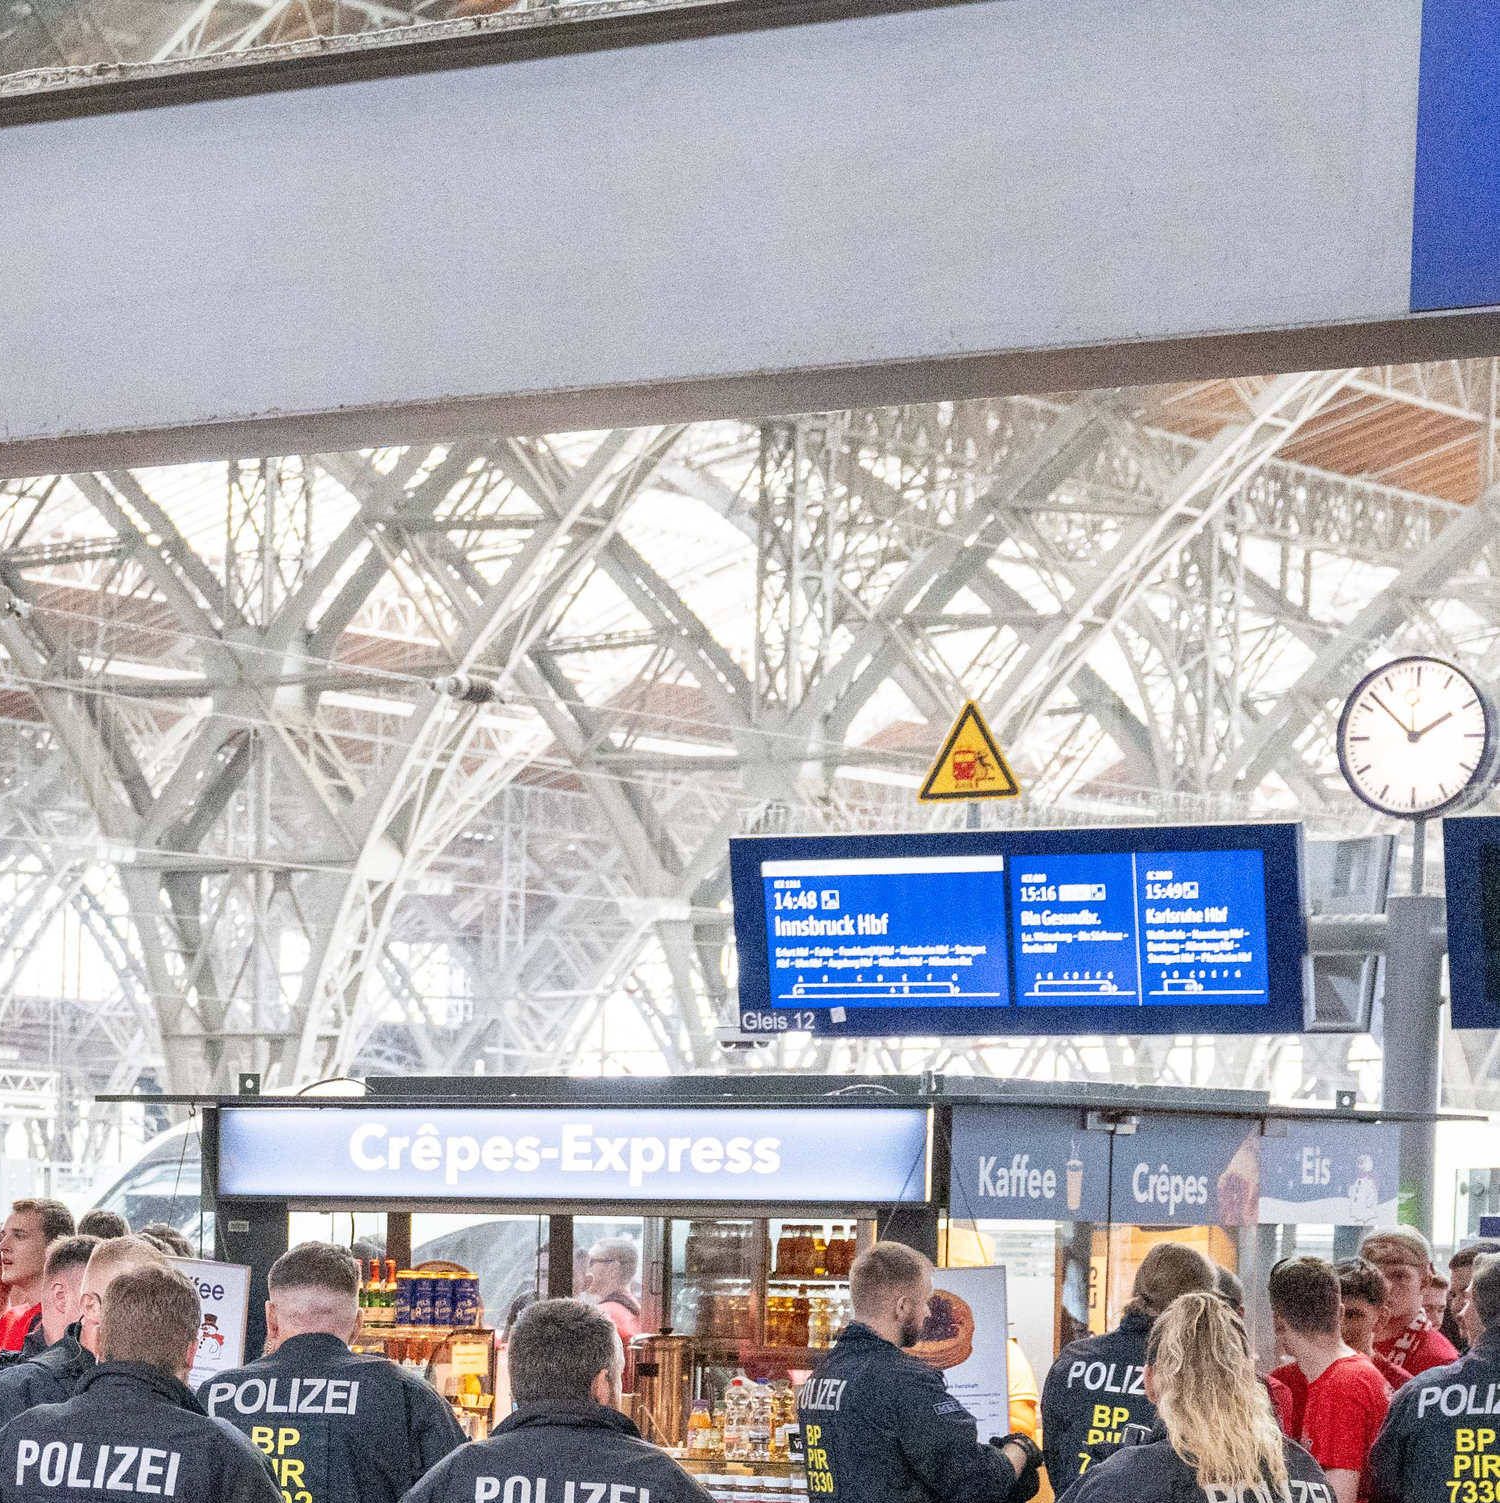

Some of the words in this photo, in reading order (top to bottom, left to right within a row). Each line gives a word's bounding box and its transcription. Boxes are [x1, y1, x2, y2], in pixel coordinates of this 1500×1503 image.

[774, 890, 818, 910] 14:48
[1020, 886, 1057, 902] 15:16
[775, 914, 855, 937] Innsbruck
[858, 912, 889, 935] Hbf
[742, 1012, 788, 1030] Gleis
[794, 1012, 815, 1029] 12
[349, 1123, 782, 1184] Crêpes-Express
[1302, 1146, 1331, 1185] Eis
[978, 1154, 1057, 1199] Kaffee
[1131, 1163, 1208, 1216] Crêpes
[1068, 1360, 1147, 1395] POLIZ
[208, 1378, 359, 1417] POLIZEI
[1092, 1404, 1129, 1429] BP
[252, 1426, 300, 1455] BP
[806, 1425, 821, 1446] BP
[1455, 1429, 1496, 1452] BP
[16, 1440, 181, 1496] POLIZEI
[807, 1449, 829, 1470] PIR
[1453, 1454, 1500, 1479] PIR
[271, 1458, 305, 1488] IR
[808, 1471, 834, 1493] 7330
